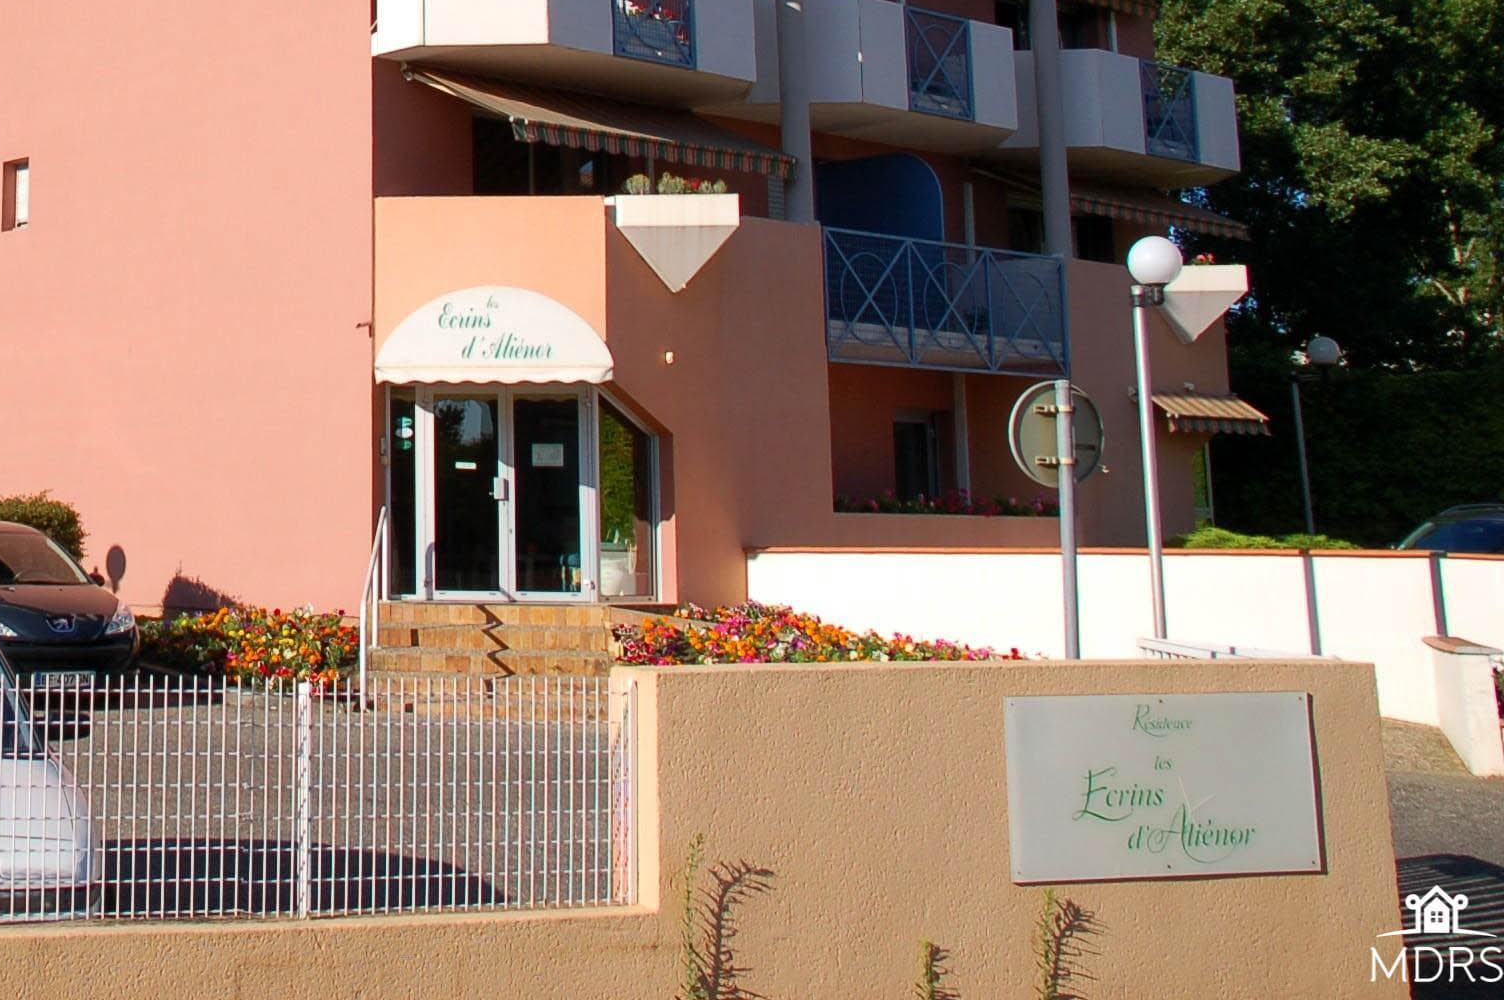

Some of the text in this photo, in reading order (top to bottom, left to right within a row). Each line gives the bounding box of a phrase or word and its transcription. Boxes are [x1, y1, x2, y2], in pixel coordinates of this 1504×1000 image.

[438, 302, 491, 328] Ecrins
[1154, 755, 1175, 771] les
[1072, 766, 1165, 821] Ecrins
